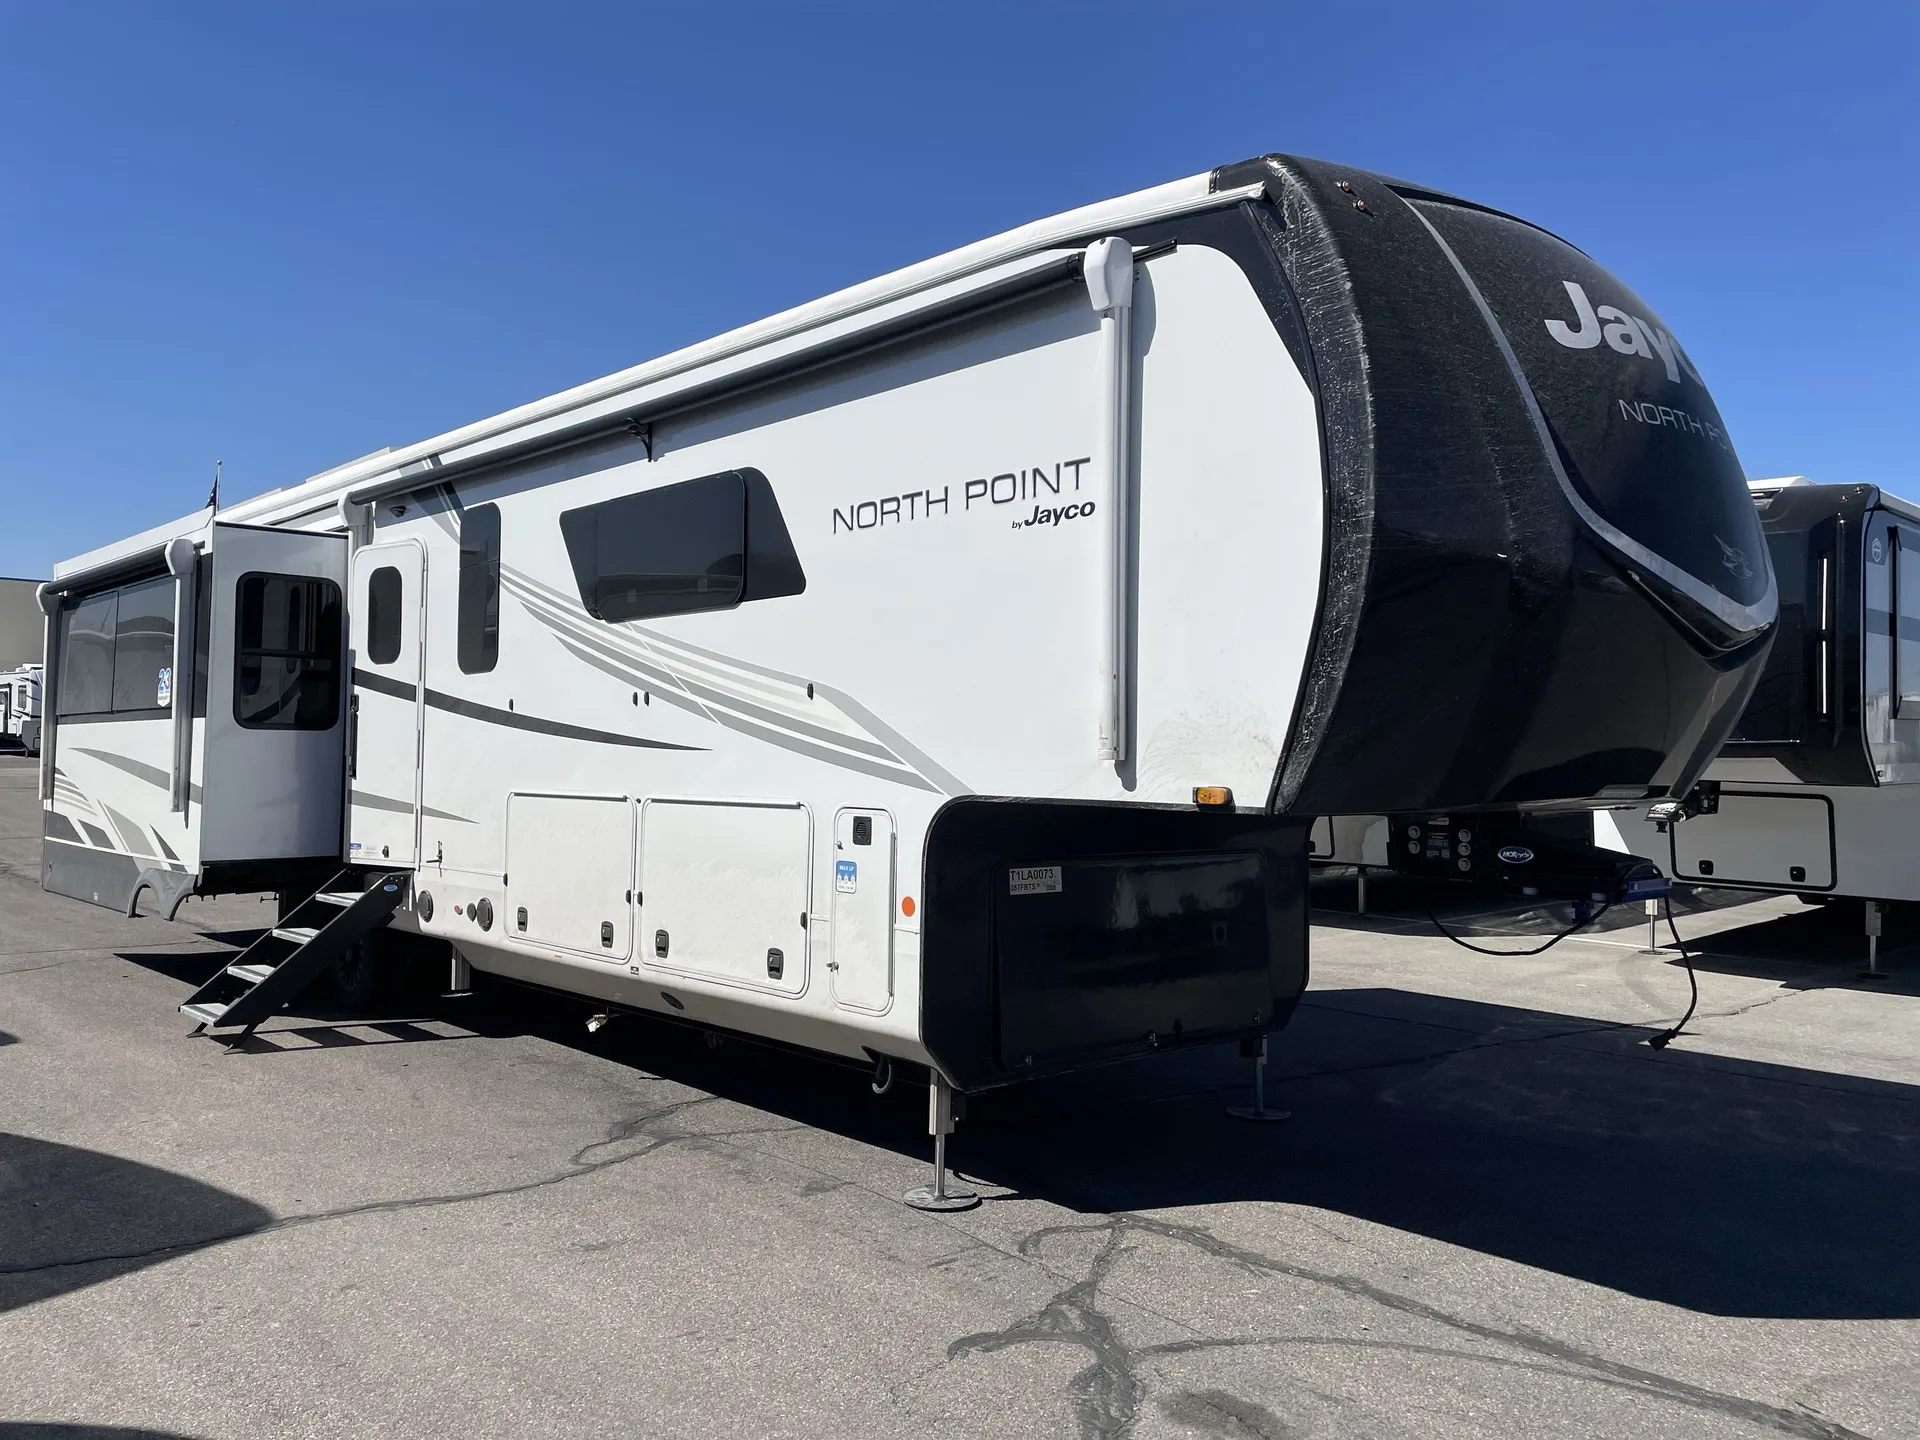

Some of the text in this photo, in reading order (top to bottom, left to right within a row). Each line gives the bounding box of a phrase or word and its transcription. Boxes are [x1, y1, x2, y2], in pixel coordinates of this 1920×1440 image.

[1618, 398, 1704, 438] NORTH
[832, 456, 1092, 535] NORTH POINT
[1011, 500, 1096, 530] by Jayco
[1010, 868, 1054, 881] T1LA0073
